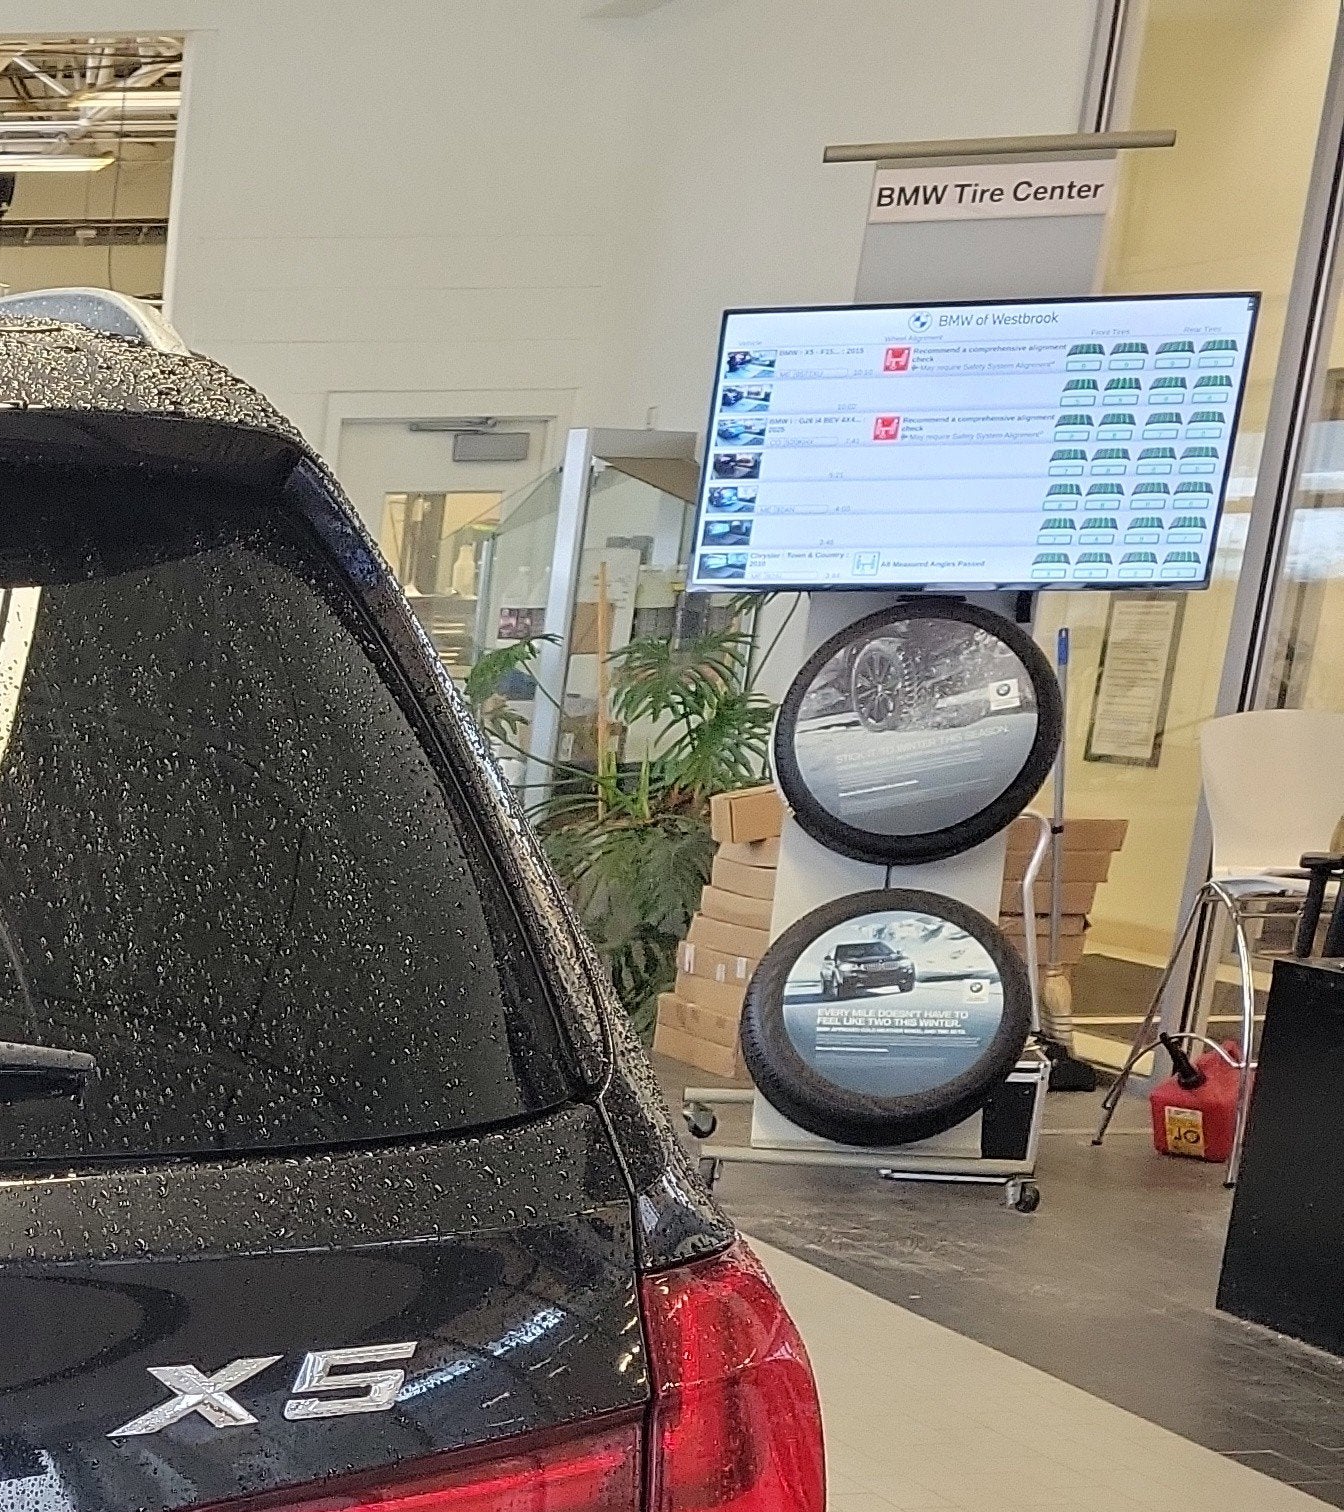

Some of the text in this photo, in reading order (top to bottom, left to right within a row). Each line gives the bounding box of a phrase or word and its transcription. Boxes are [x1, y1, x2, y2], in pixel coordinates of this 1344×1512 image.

[877, 181, 1104, 207] BMW Tire Center
[939, 312, 1059, 327] BMW of Westbrook
[969, 345, 1026, 354] comprehensive
[958, 415, 1015, 424] comprehensive
[817, 1008, 969, 1019] EVERY MILE DOESN'T HAVE TO
[817, 1017, 841, 1025] FEEL
[843, 1017, 867, 1026] LIKE
[868, 1018, 892, 1026] TWO
[894, 1018, 916, 1027] THIS
[105, 1341, 418, 1437] X5
